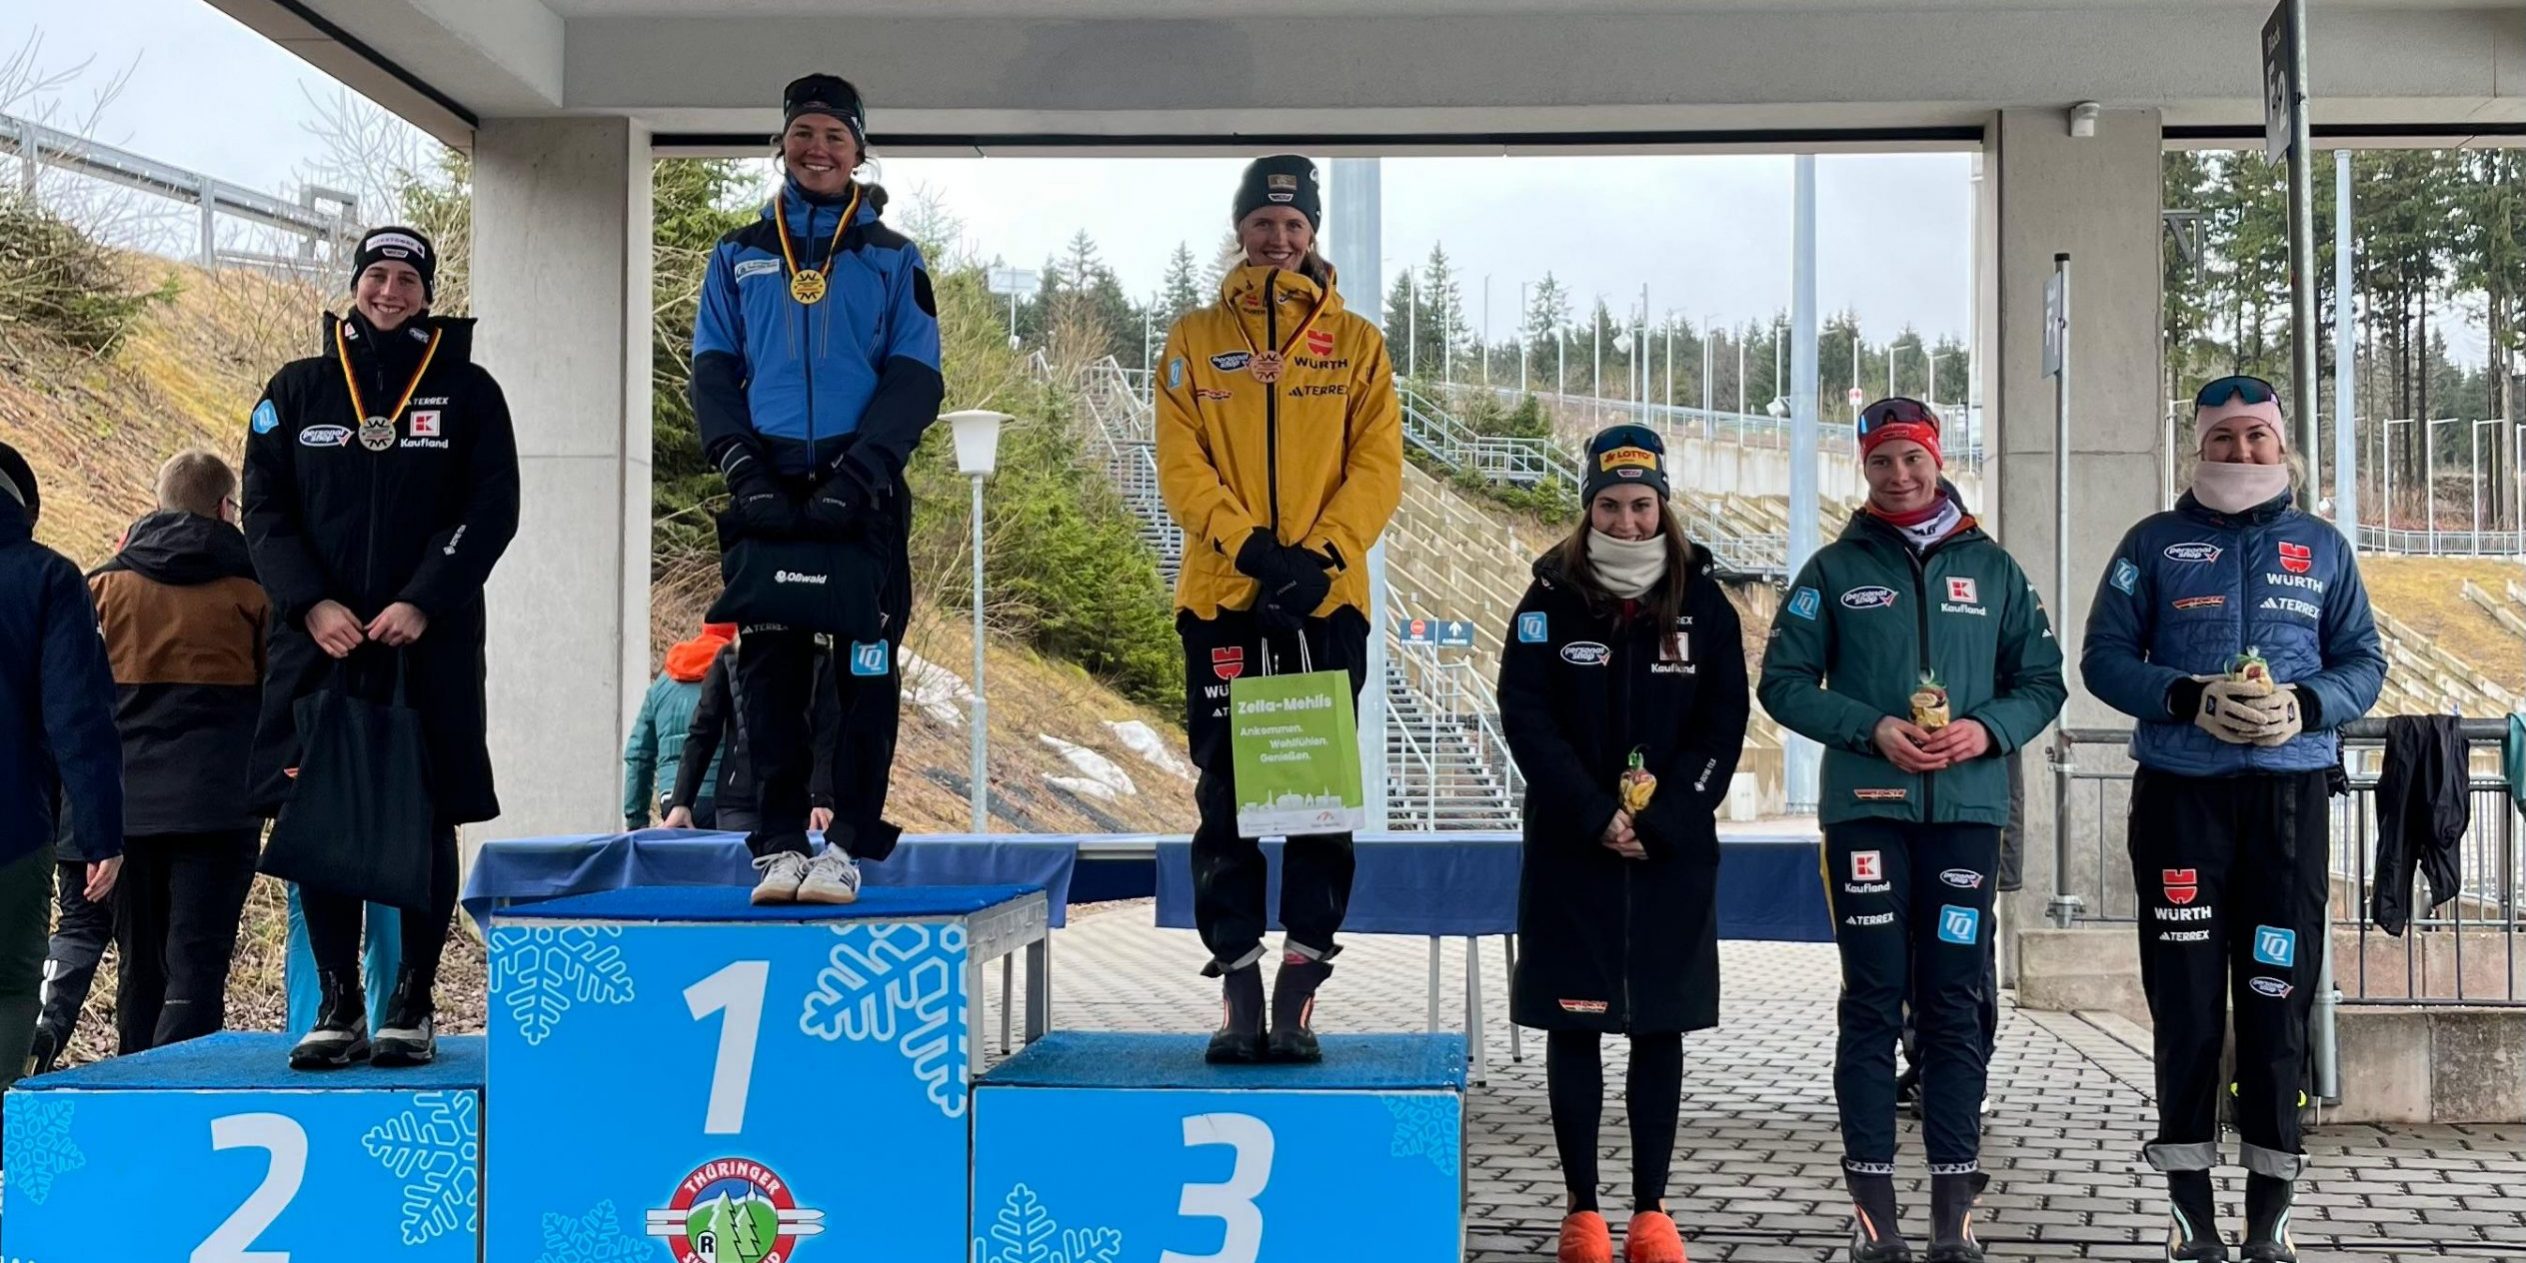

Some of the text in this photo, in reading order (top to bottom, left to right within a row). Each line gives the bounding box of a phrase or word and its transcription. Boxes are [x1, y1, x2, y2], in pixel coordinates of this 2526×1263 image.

[400, 438, 449, 449] Kaufland
[1617, 450, 1649, 460] LOTTO
[1845, 589, 1888, 602] personal
[1941, 603, 1986, 616] Kaufland
[1523, 616, 1543, 638] TQ
[858, 644, 882, 671] TQ
[1238, 693, 1332, 714] Zella-Mehlis
[1240, 725, 1303, 736] Ankommen.
[1845, 880, 1891, 893] Kaufland
[1857, 911, 1894, 926] TERREX
[1946, 911, 1973, 940] TQ
[2170, 929, 2210, 941] TERREX
[2261, 931, 2288, 961] TQ
[683, 960, 770, 1135] 1
[189, 1112, 309, 1263] 2
[684, 1160, 782, 1196] THÜRINGER
[1159, 1112, 1275, 1263] 3
[700, 1236, 714, 1253] R
